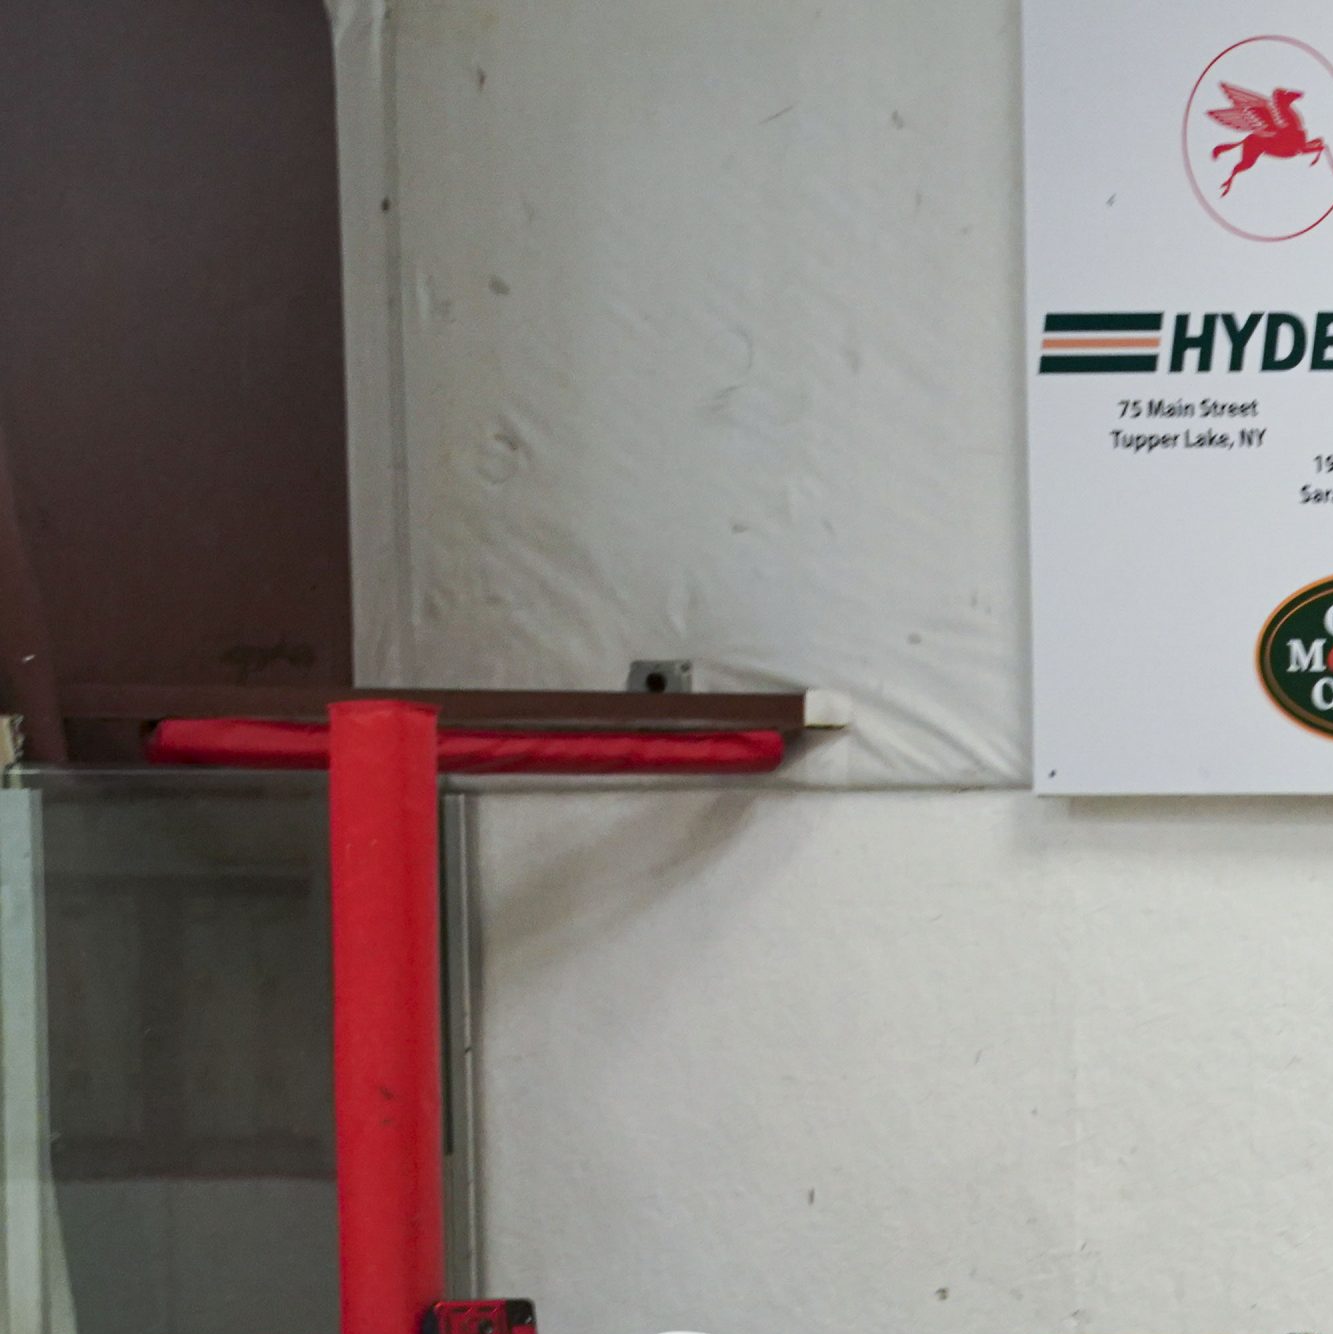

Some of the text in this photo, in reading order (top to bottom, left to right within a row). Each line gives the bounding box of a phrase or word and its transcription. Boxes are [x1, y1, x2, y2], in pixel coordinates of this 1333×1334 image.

[1117, 397, 1259, 419] 75 Main Street
[1109, 427, 1267, 454] Tupper Lake, NY
